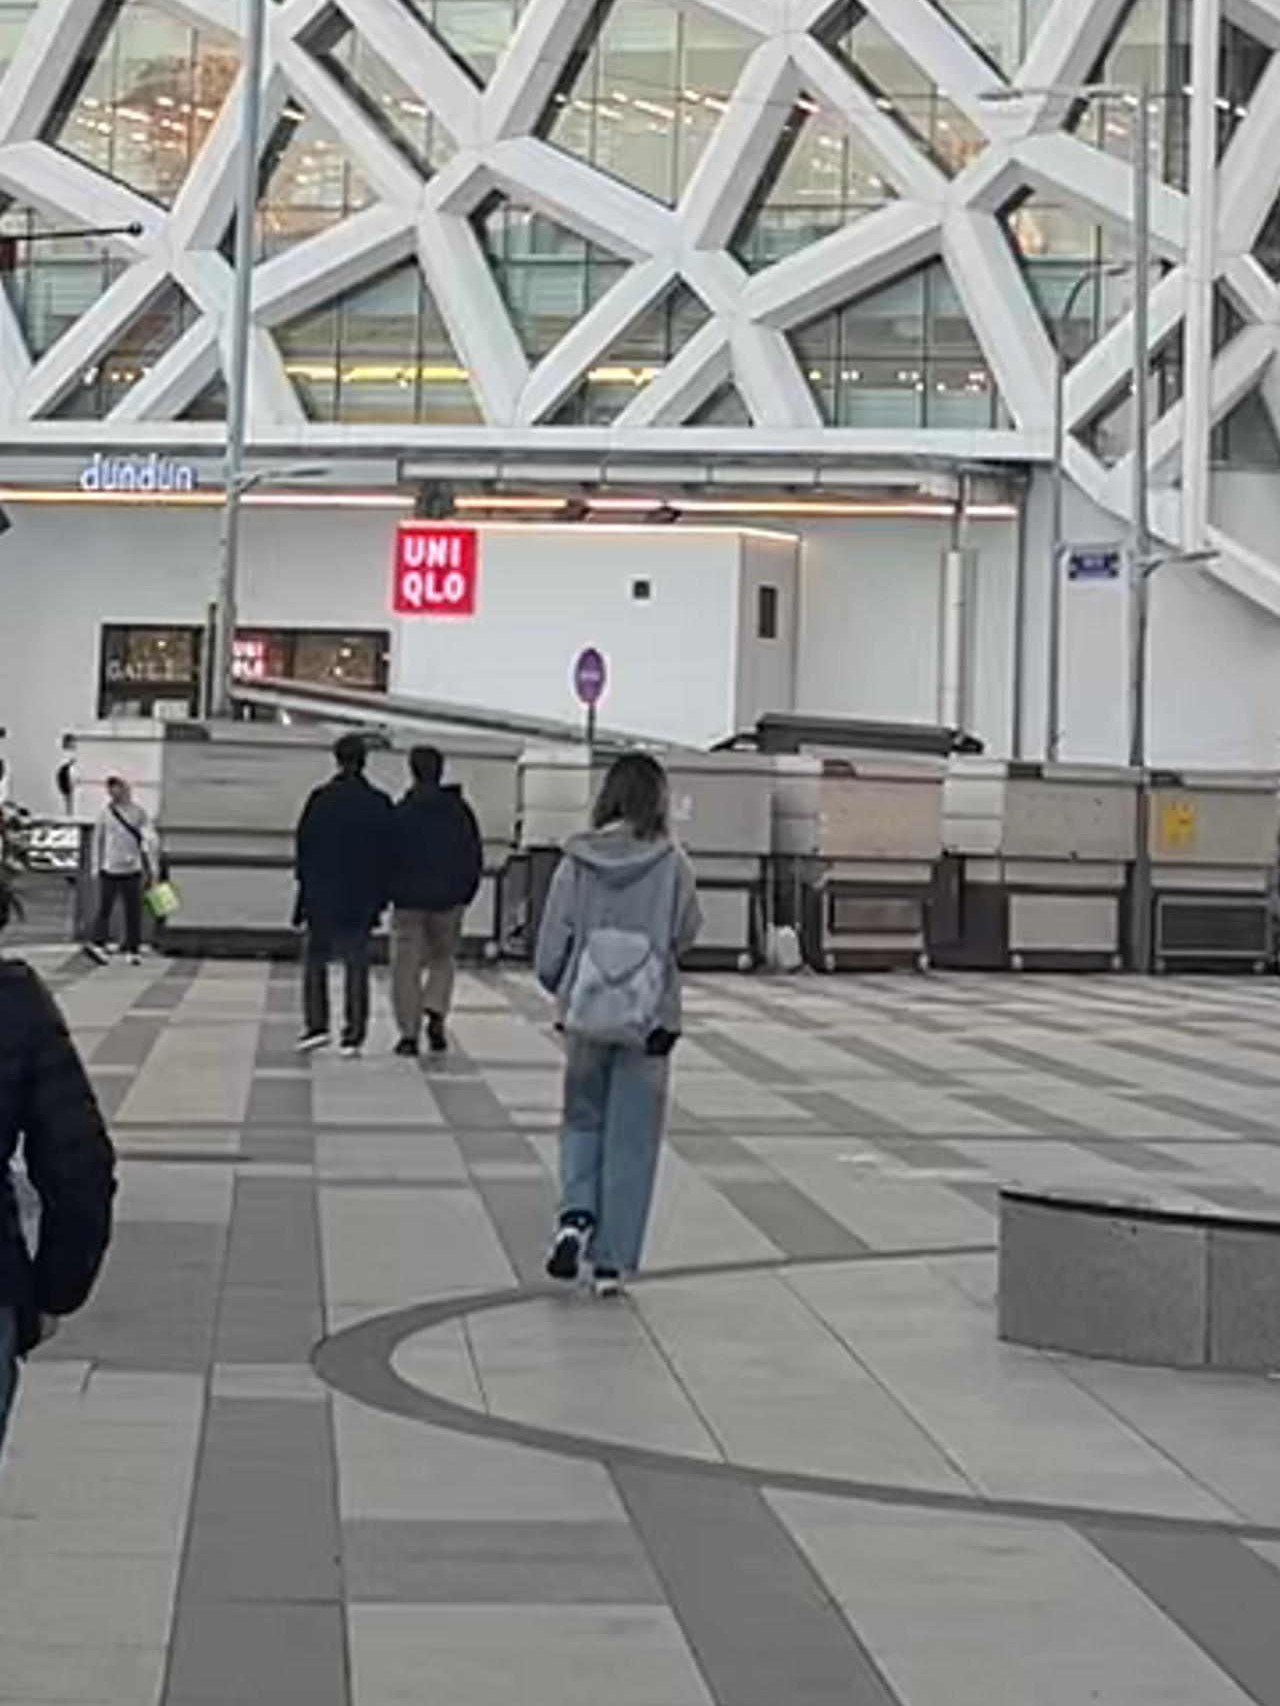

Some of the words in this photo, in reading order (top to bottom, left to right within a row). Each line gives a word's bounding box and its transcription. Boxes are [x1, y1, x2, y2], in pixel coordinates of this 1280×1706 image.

[80, 452, 195, 490] dundun
[404, 535, 461, 568] UNI
[402, 570, 466, 608] QLO
